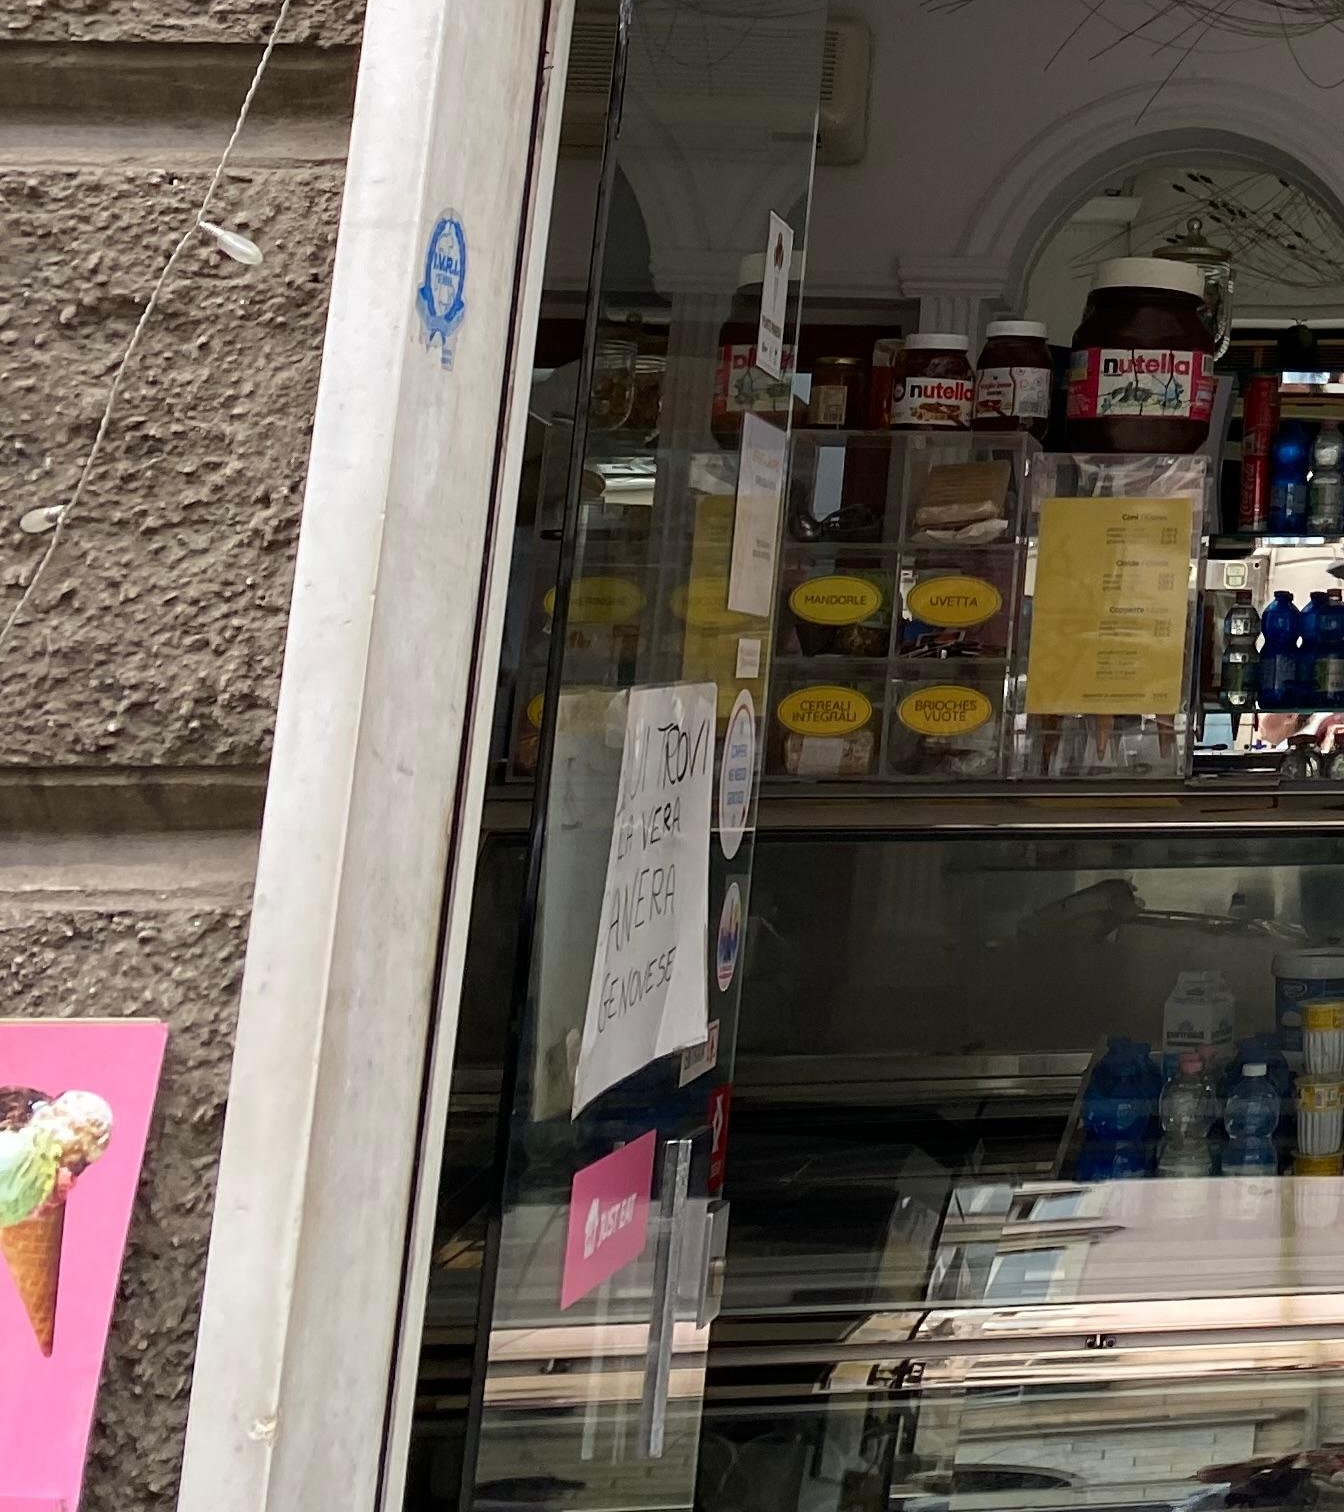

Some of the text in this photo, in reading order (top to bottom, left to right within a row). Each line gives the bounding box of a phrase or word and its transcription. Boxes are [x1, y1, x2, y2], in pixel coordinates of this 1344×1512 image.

[1103, 356, 1190, 376] nutella
[909, 381, 974, 402] nutella
[804, 595, 867, 607] MANDORLE
[929, 595, 978, 608] UVETTA
[800, 700, 850, 712] CEREALI
[914, 699, 977, 712] BRIOCHES
[792, 710, 857, 723] INTEGRALI
[924, 711, 966, 723] VUOTE
[641, 797, 681, 852] VERA
[597, 945, 678, 1034] GENOVESE
